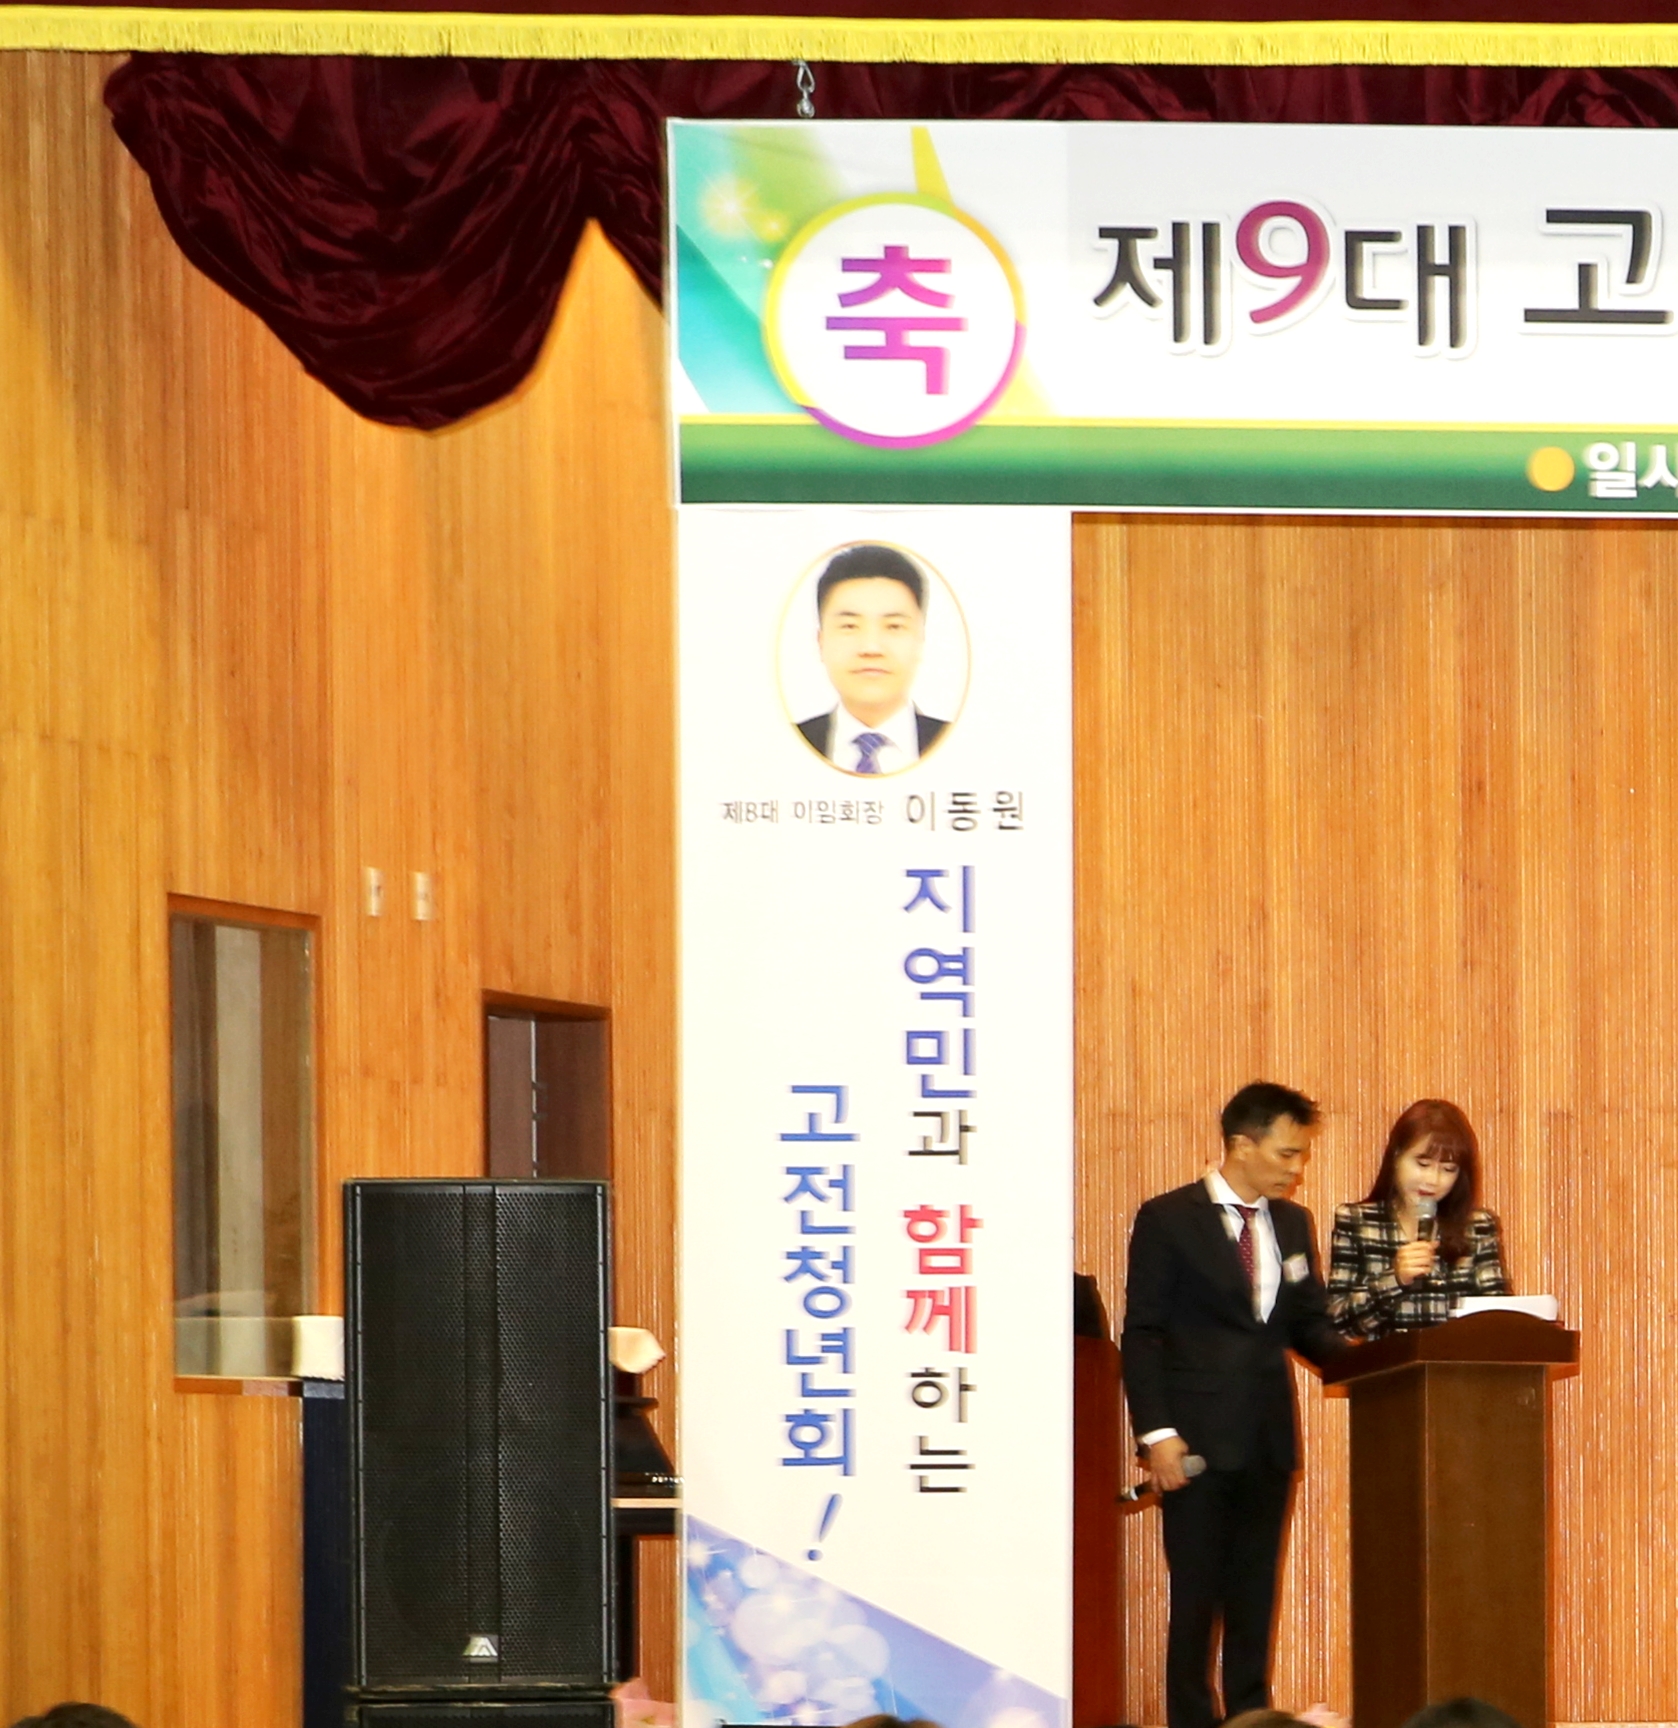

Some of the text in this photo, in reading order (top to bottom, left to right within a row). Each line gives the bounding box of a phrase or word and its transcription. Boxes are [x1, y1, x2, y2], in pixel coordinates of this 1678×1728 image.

[826, 244, 968, 396] 축
[1093, 201, 1467, 349] 제9대
[722, 790, 1023, 832] 제8대 이임회장 이동원
[903, 865, 982, 1494] 지역민과 함께하는
